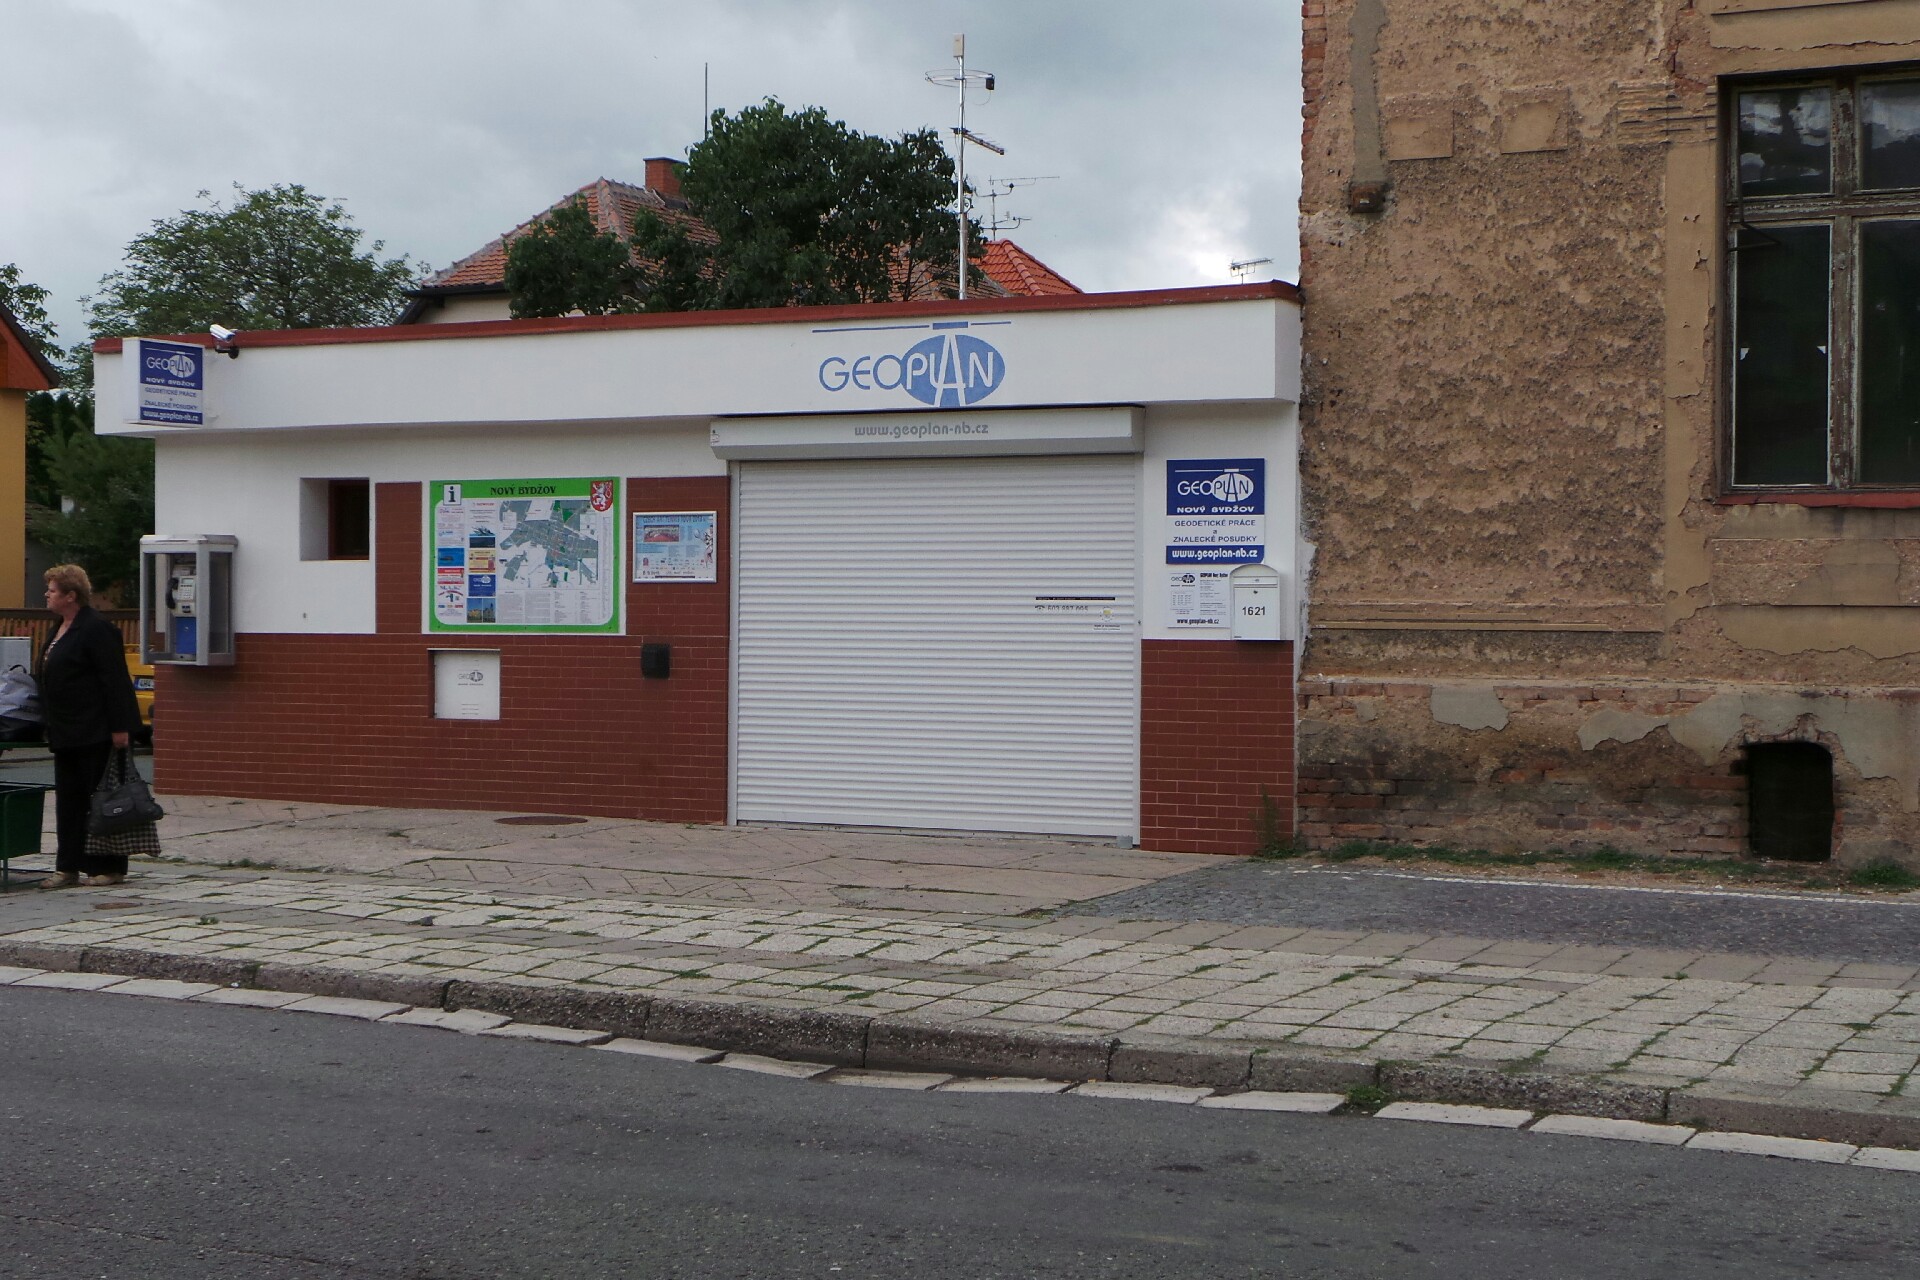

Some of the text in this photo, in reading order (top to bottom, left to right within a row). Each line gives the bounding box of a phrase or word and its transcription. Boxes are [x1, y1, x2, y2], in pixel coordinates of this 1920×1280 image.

[819, 334, 994, 407] GEOPLAN
[854, 422, 989, 438] www.geoplan-nb.cz
[490, 484, 557, 496] NOVÝ BYDŽOV
[1177, 473, 1250, 502] GEOPLAN
[1176, 505, 1255, 514] NOVÝ BYDŽOV
[1174, 518, 1256, 527] GEODETICKÉ PRÁCE
[1173, 534, 1257, 543] ZNALECKÉ POSUDKY
[1171, 548, 1258, 560] www.geoplan-nb.cz
[1241, 606, 1266, 616] 1621
